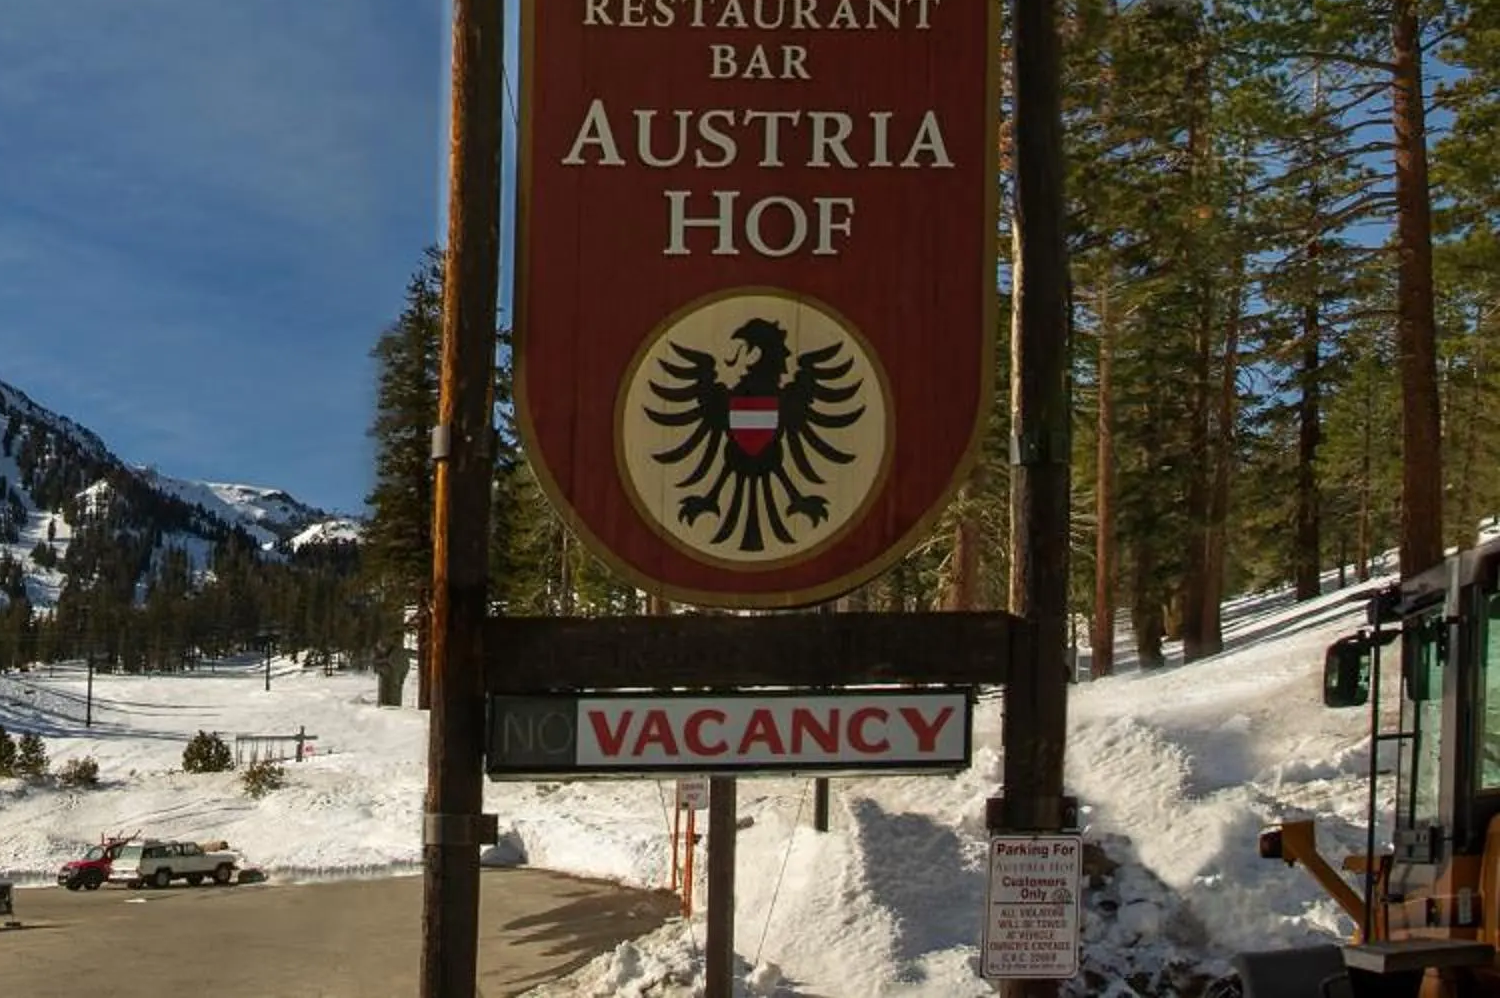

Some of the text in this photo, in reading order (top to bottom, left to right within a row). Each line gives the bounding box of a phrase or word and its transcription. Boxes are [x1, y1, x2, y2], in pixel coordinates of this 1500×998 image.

[709, 44, 812, 80] BAR
[561, 98, 955, 170] AUSTRIA
[663, 190, 855, 257] HOF
[502, 705, 955, 757] NO VACANCY
[997, 843, 1075, 859] Parking For
[1002, 875, 1067, 887] Customers
[1021, 888, 1048, 902] Only
